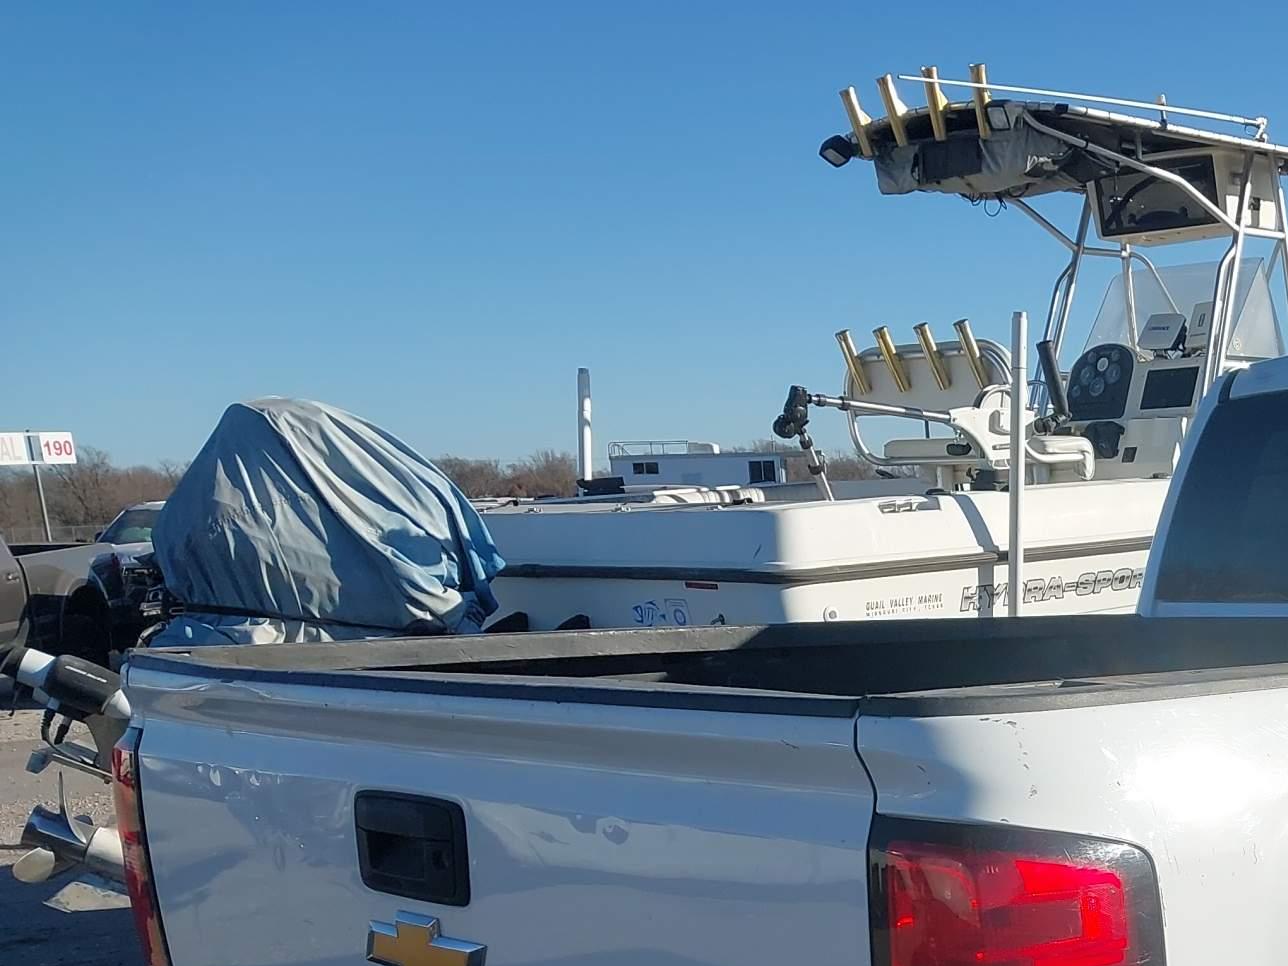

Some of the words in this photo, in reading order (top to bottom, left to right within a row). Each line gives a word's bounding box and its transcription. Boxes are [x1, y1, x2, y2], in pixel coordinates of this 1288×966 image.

[43, 440, 72, 456] 190
[890, 596, 913, 608] VALLEY
[918, 593, 943, 605] MARINE
